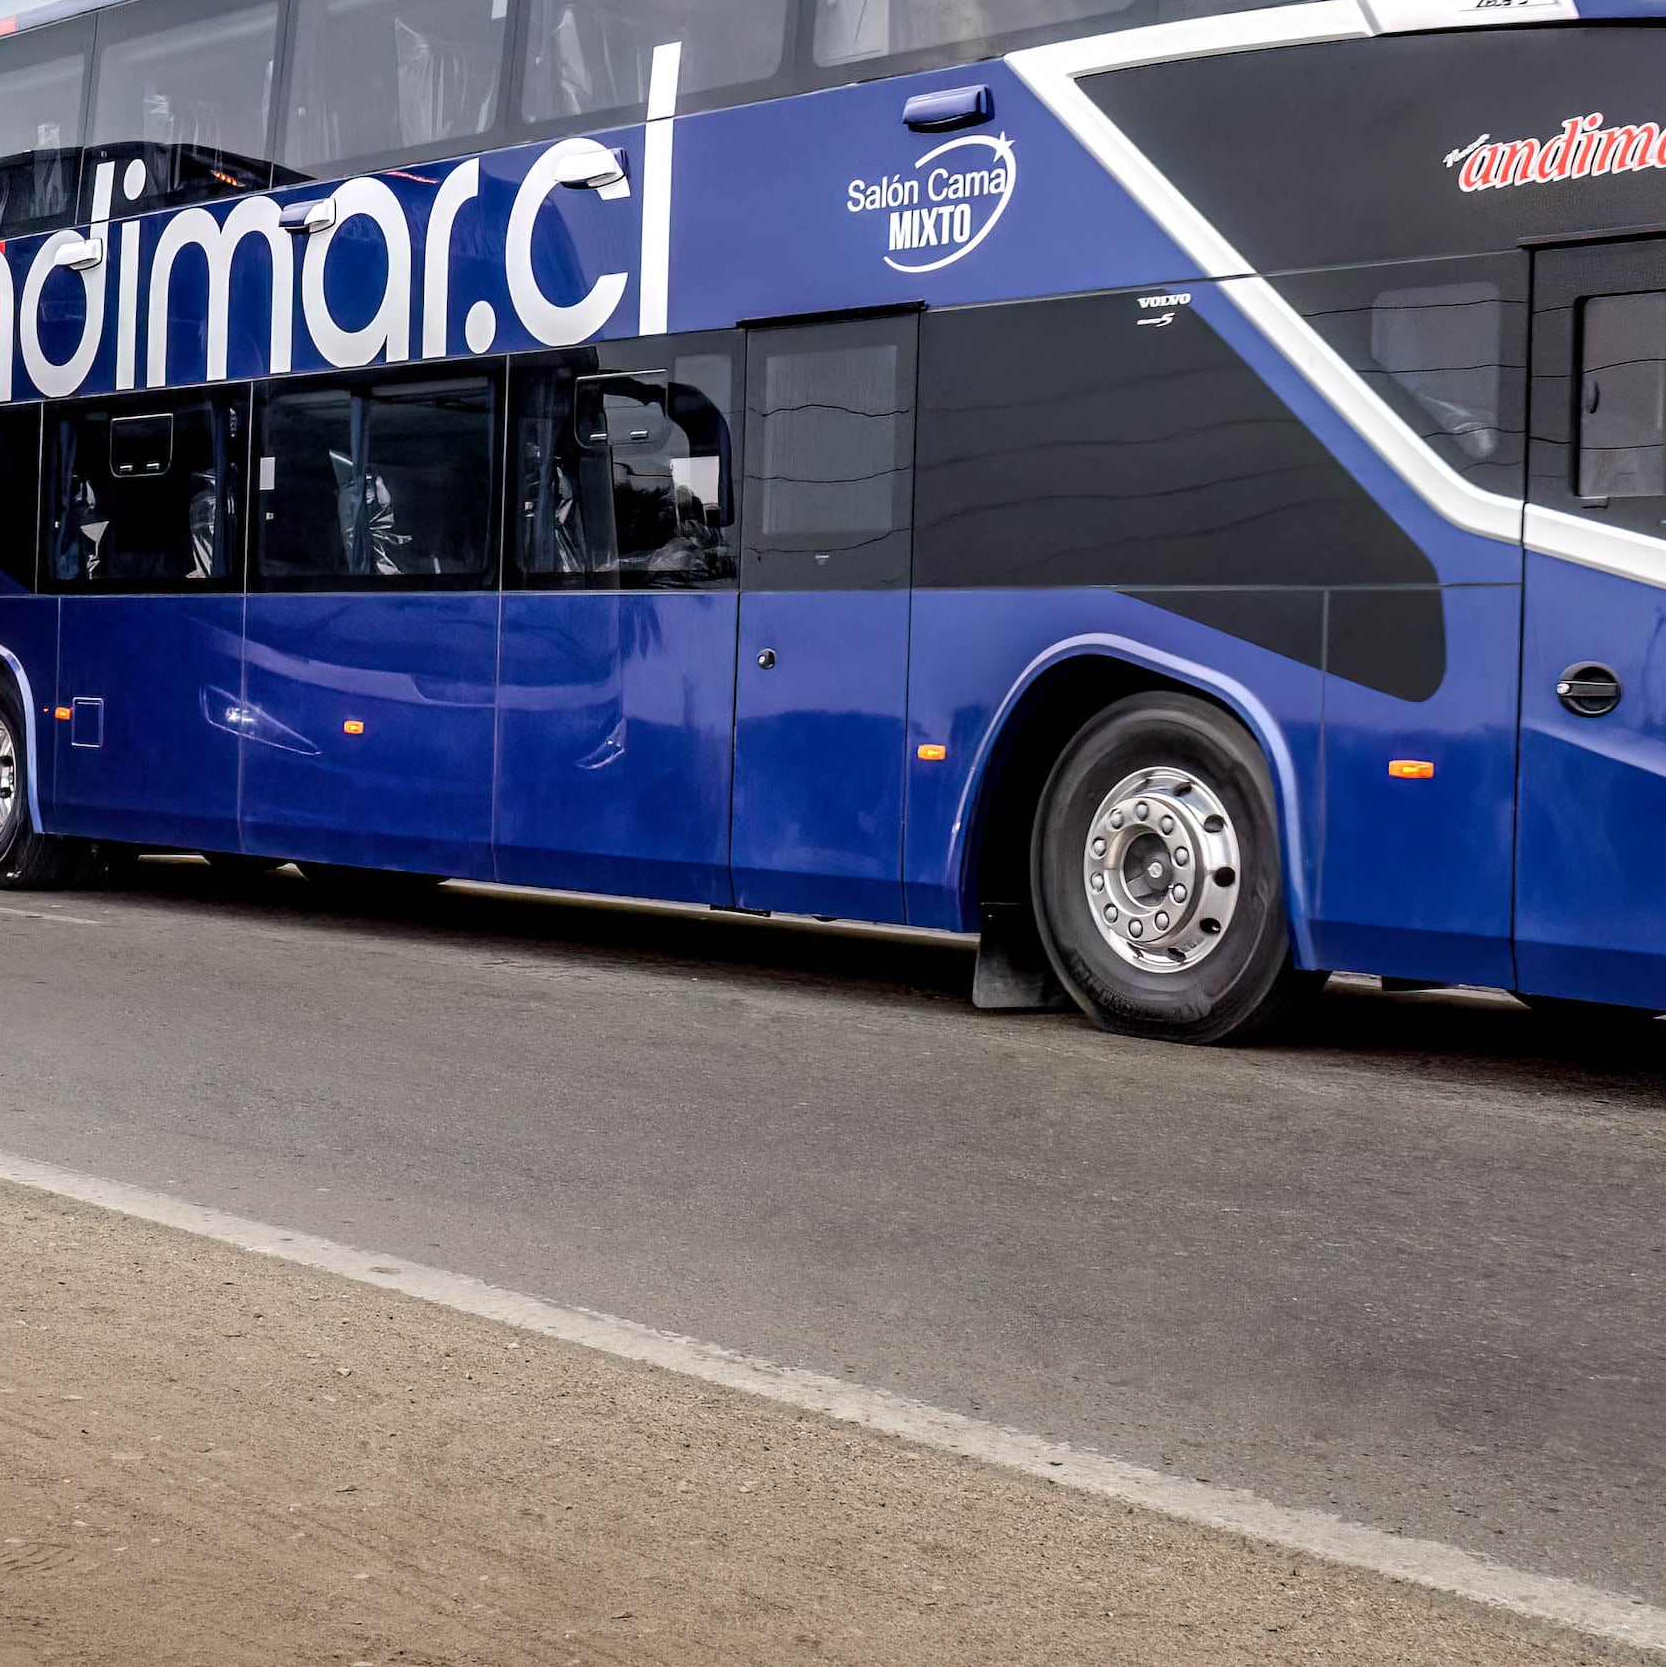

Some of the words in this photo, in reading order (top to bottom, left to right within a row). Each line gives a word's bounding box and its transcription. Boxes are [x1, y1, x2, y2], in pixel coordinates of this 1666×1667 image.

[846, 174, 919, 212] Salón
[927, 168, 1006, 202] Cama
[889, 203, 971, 251] MIXTO
[1137, 293, 1192, 309] VOLVO
